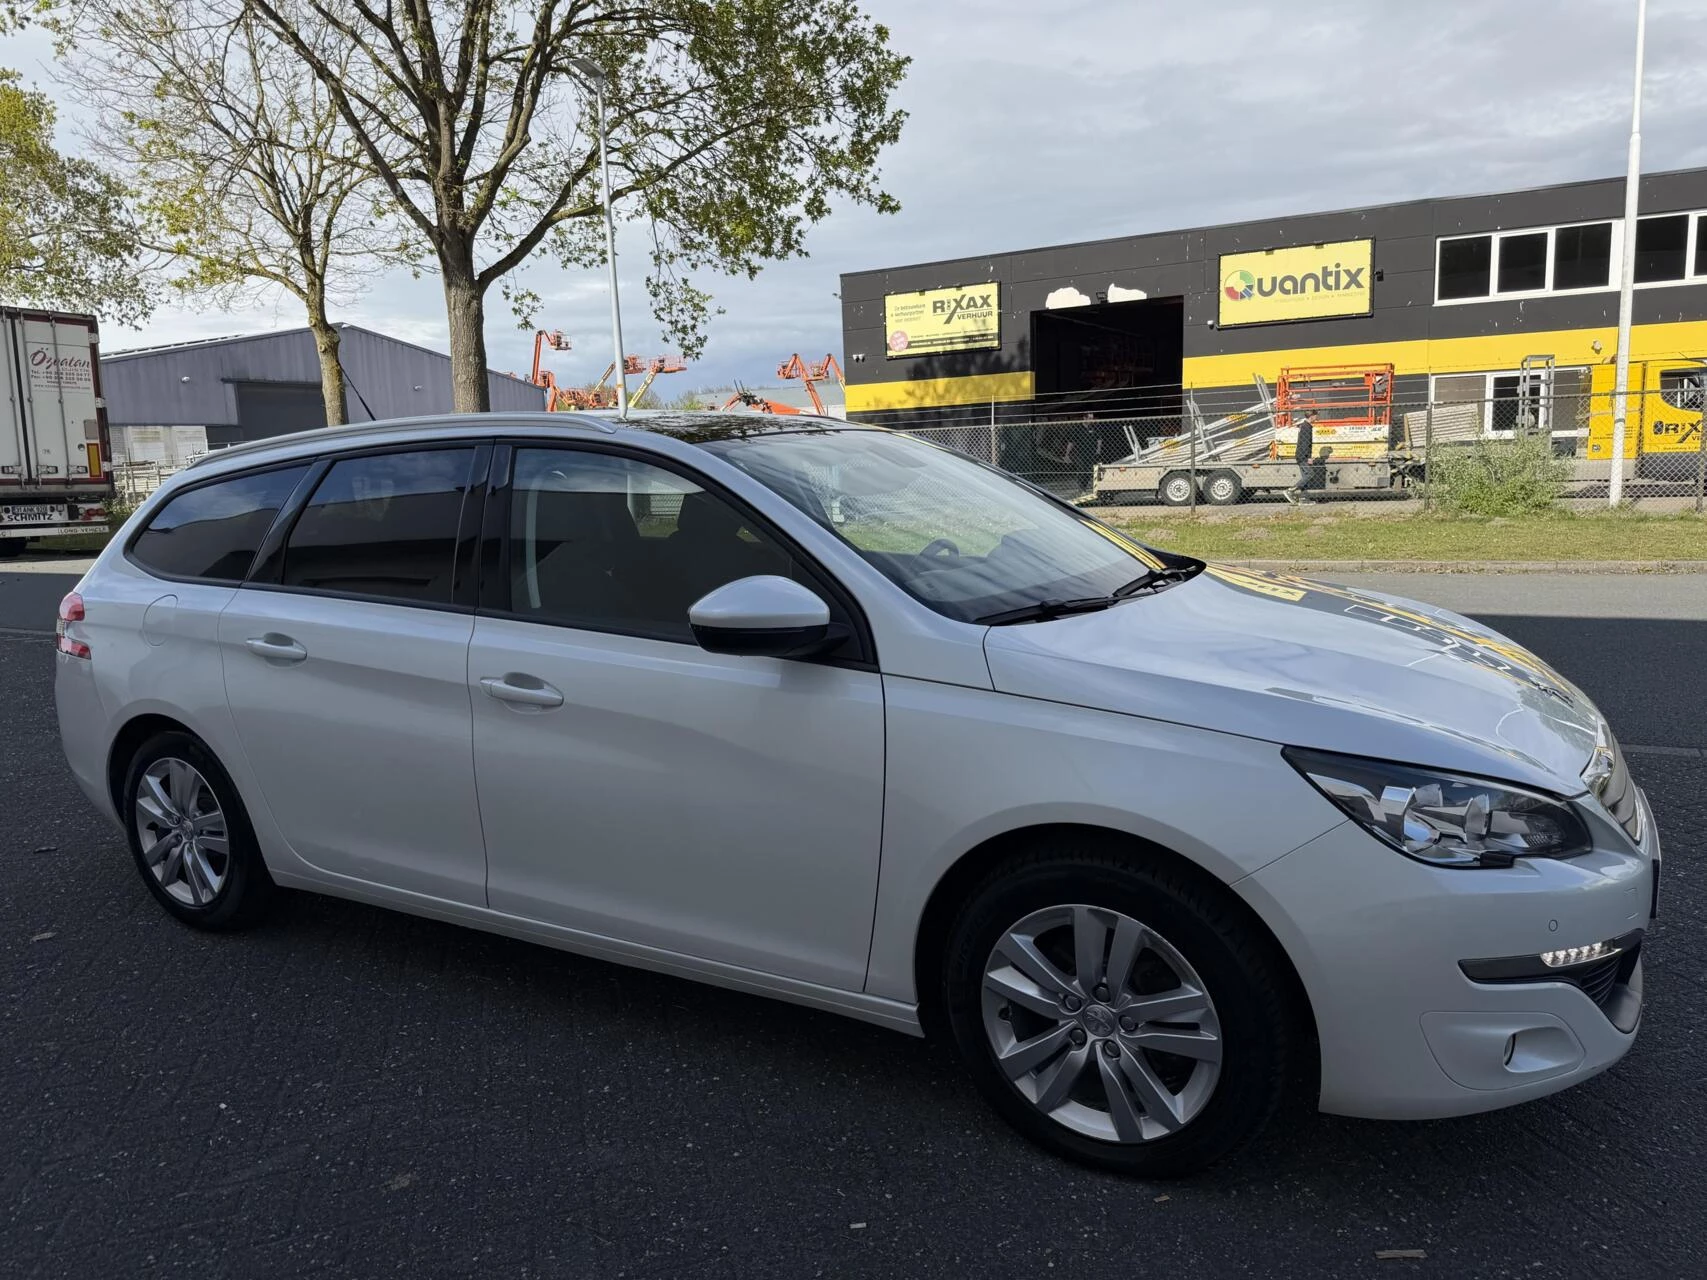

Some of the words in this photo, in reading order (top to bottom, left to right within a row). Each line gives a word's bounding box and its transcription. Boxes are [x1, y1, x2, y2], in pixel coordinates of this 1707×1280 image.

[1224, 262, 1365, 301] Quantix
[957, 311, 993, 320] VERHUUR
[7, 512, 53, 521] SCHMITZ
